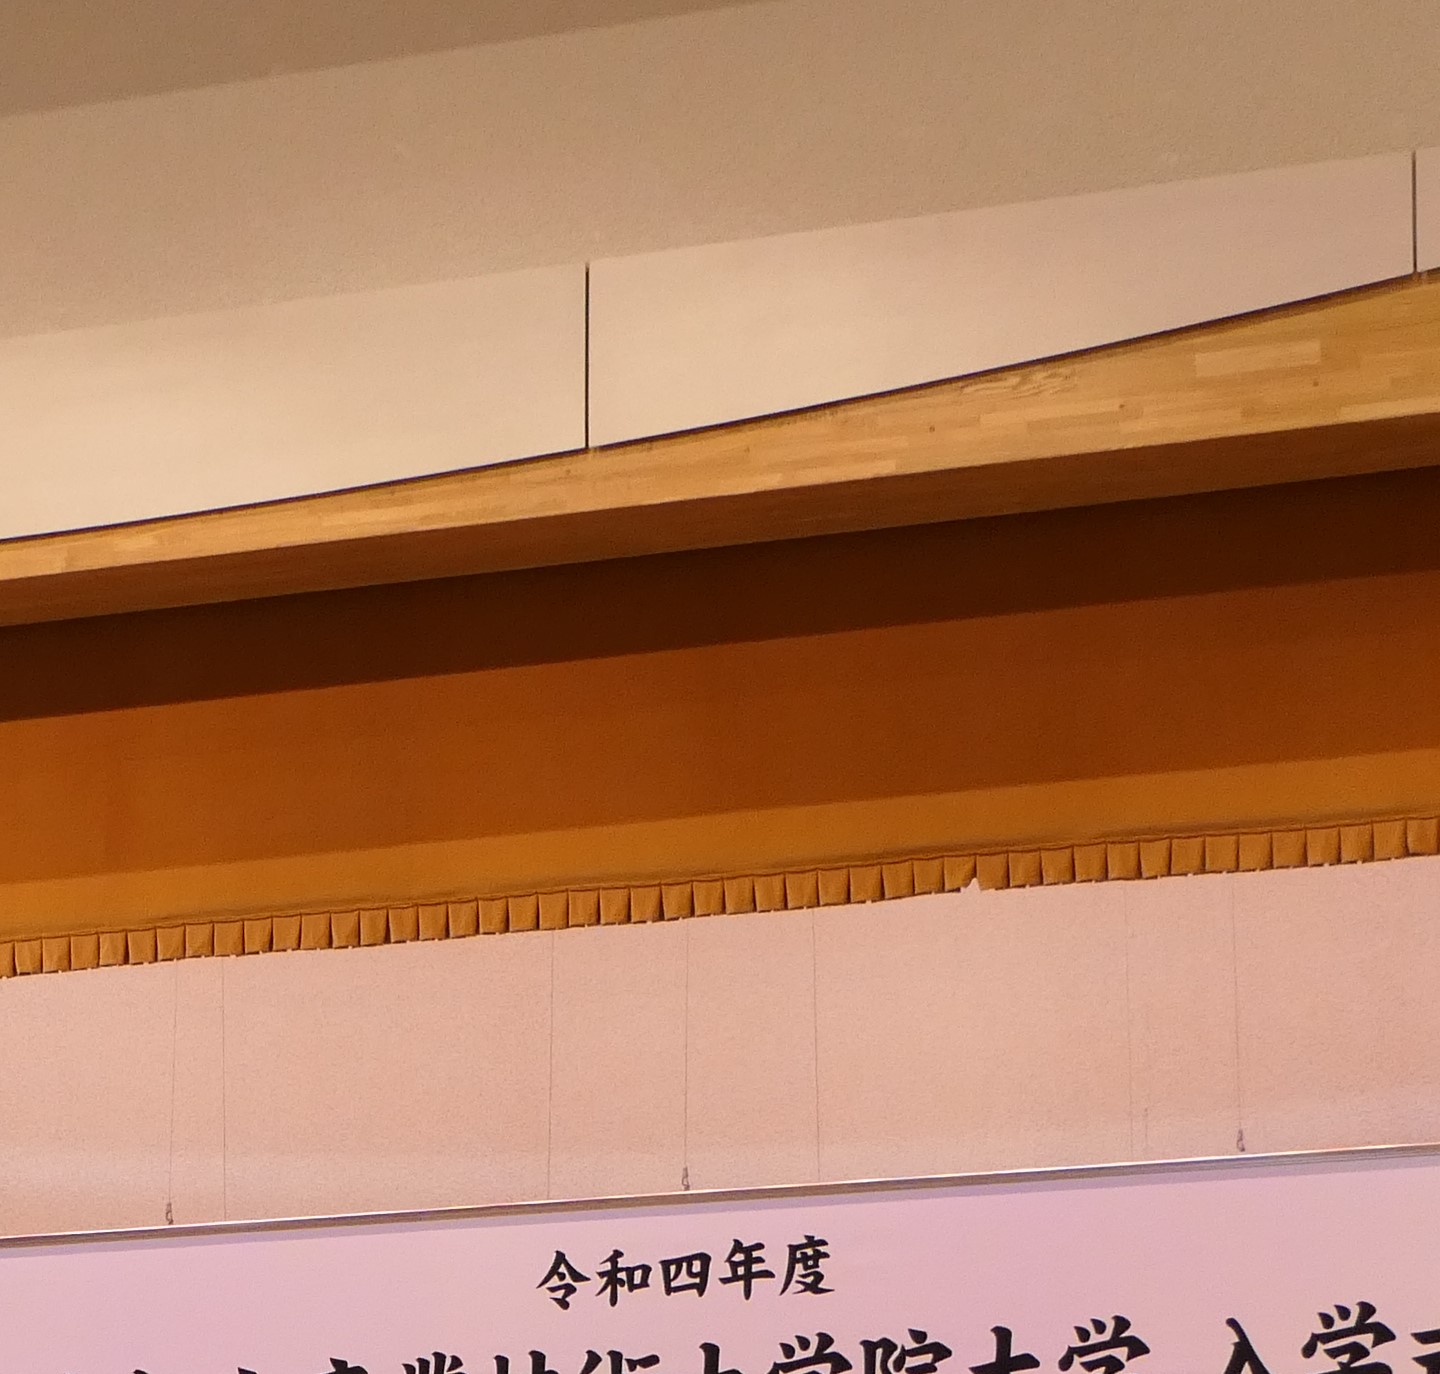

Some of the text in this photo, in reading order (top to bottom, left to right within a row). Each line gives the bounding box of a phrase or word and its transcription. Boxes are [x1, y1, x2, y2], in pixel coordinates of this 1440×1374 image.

[536, 1234, 835, 1311] 令和四年度
